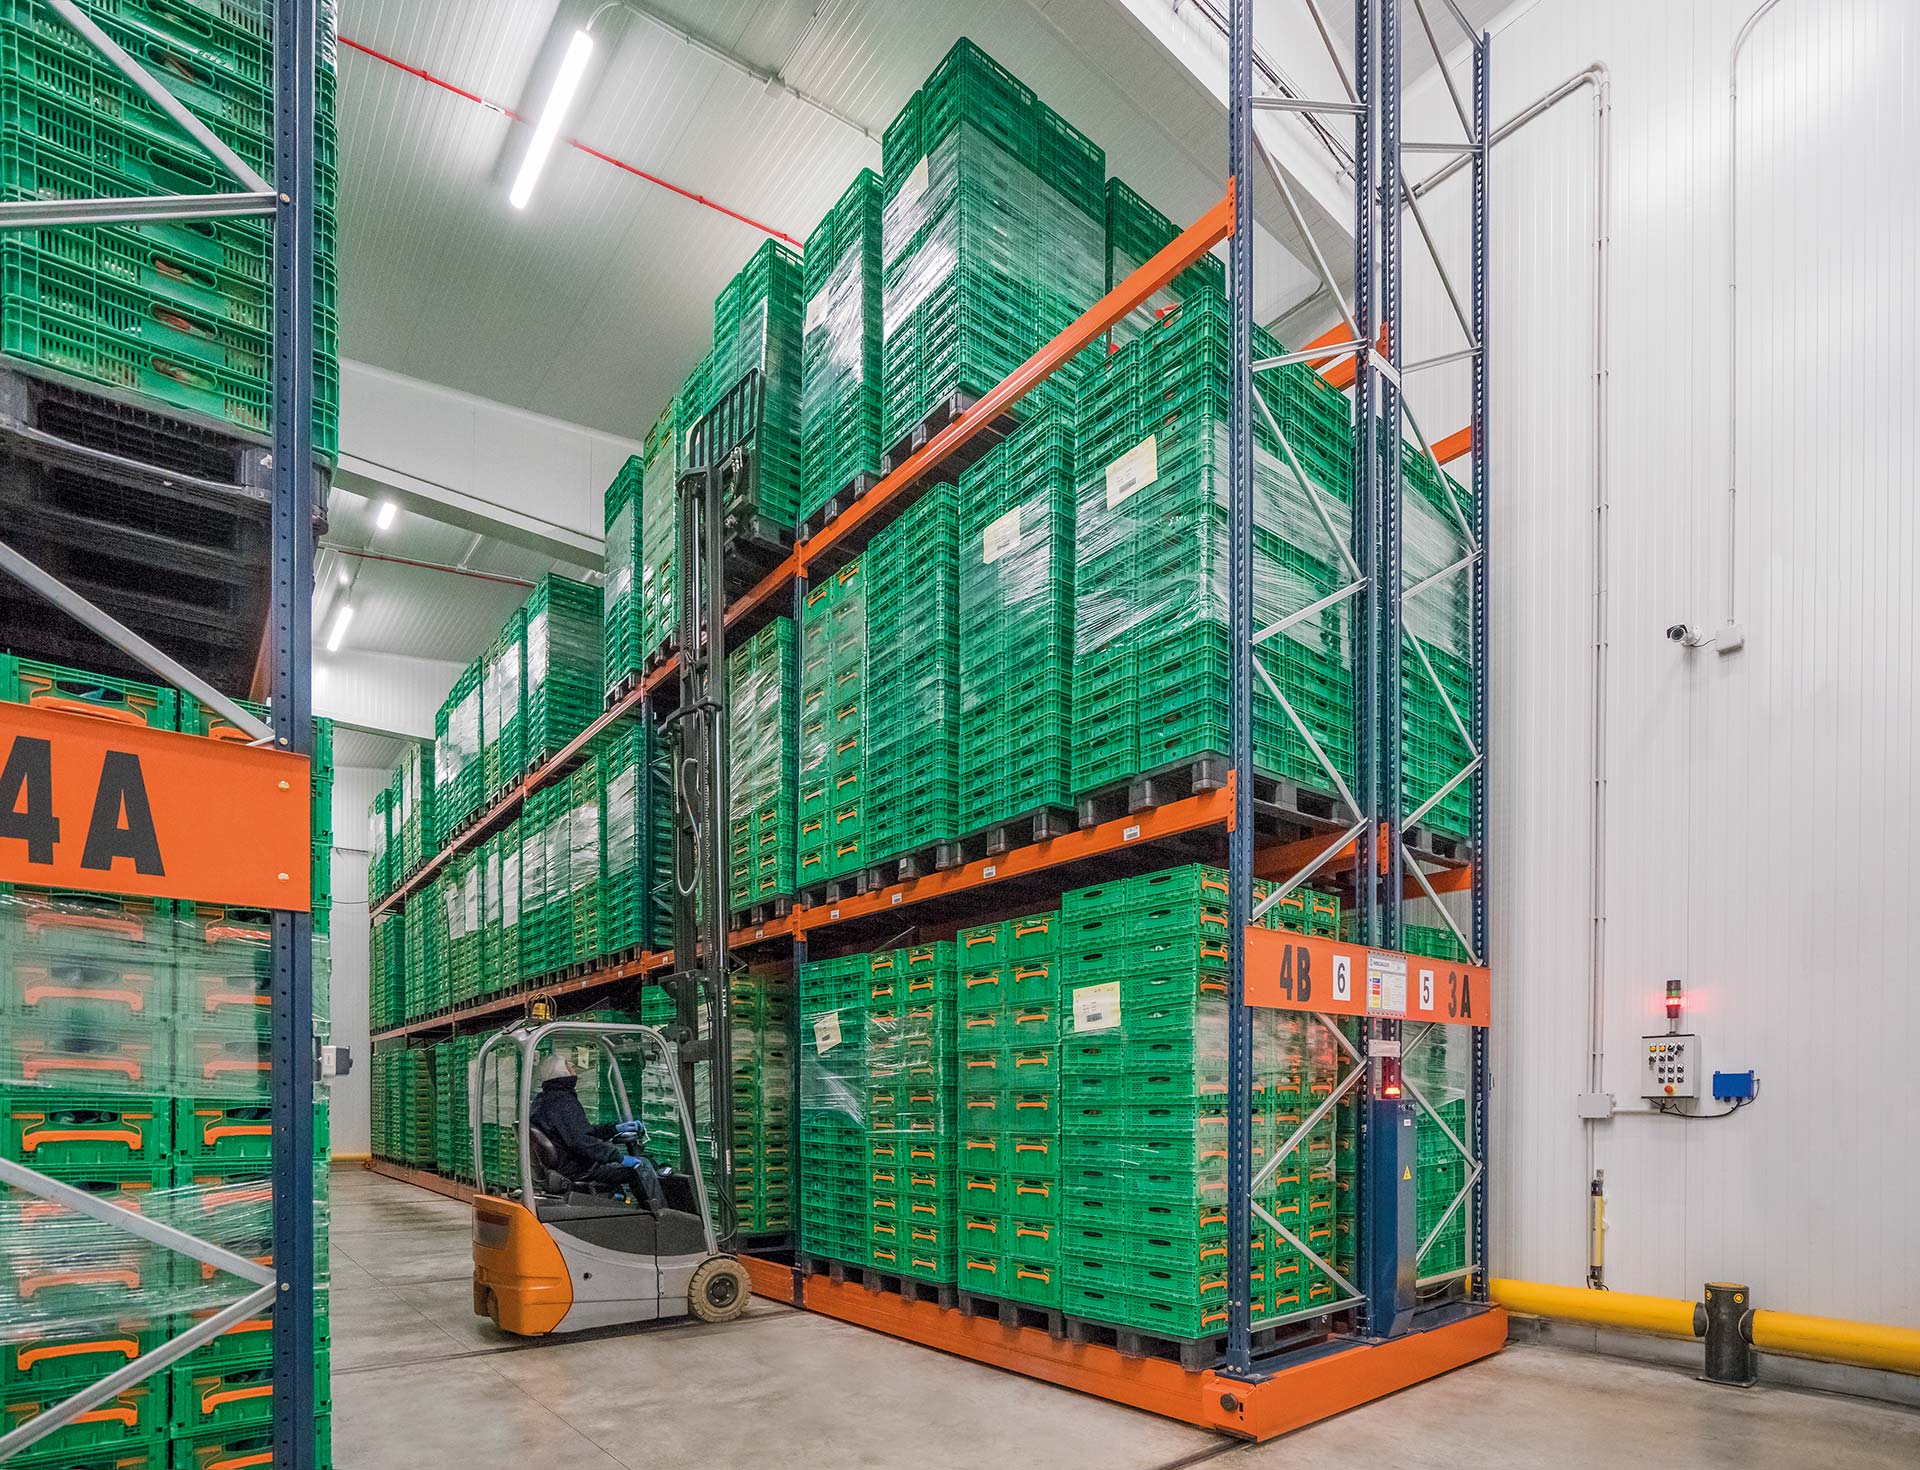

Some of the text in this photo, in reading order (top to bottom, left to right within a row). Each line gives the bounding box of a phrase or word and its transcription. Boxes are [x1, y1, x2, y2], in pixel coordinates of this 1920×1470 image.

[0, 735, 166, 877] 4A
[1279, 944, 1312, 1002] 4B
[1337, 962, 1346, 994] 6
[1423, 976, 1430, 1004] 5
[1448, 971, 1472, 1019] 3A
